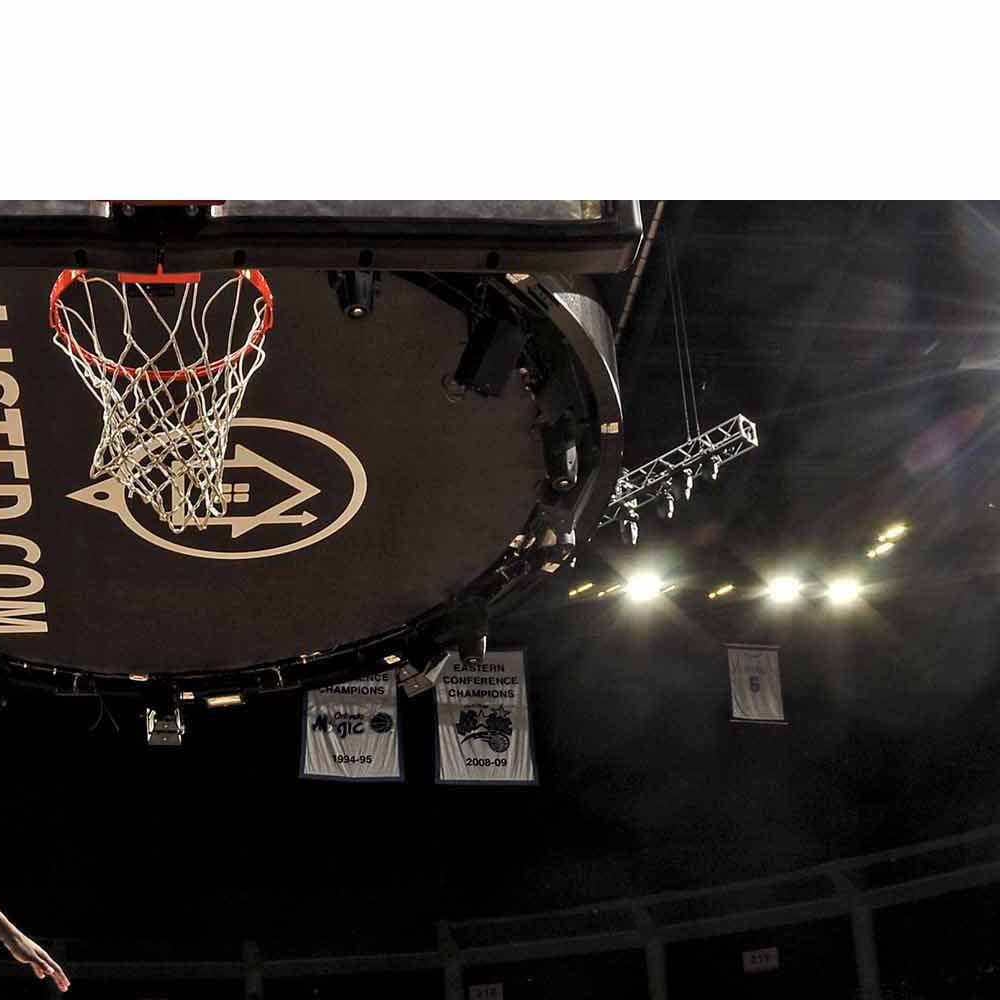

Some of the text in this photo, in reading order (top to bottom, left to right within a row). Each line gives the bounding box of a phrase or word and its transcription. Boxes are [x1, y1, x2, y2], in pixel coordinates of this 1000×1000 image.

[453, 663, 505, 673] EASTERN
[442, 675, 519, 686] CONFERENCE
[448, 688, 515, 699] CHAMPIONS
[332, 754, 373, 765] 1994-95
[465, 757, 508, 768] 2008-09
